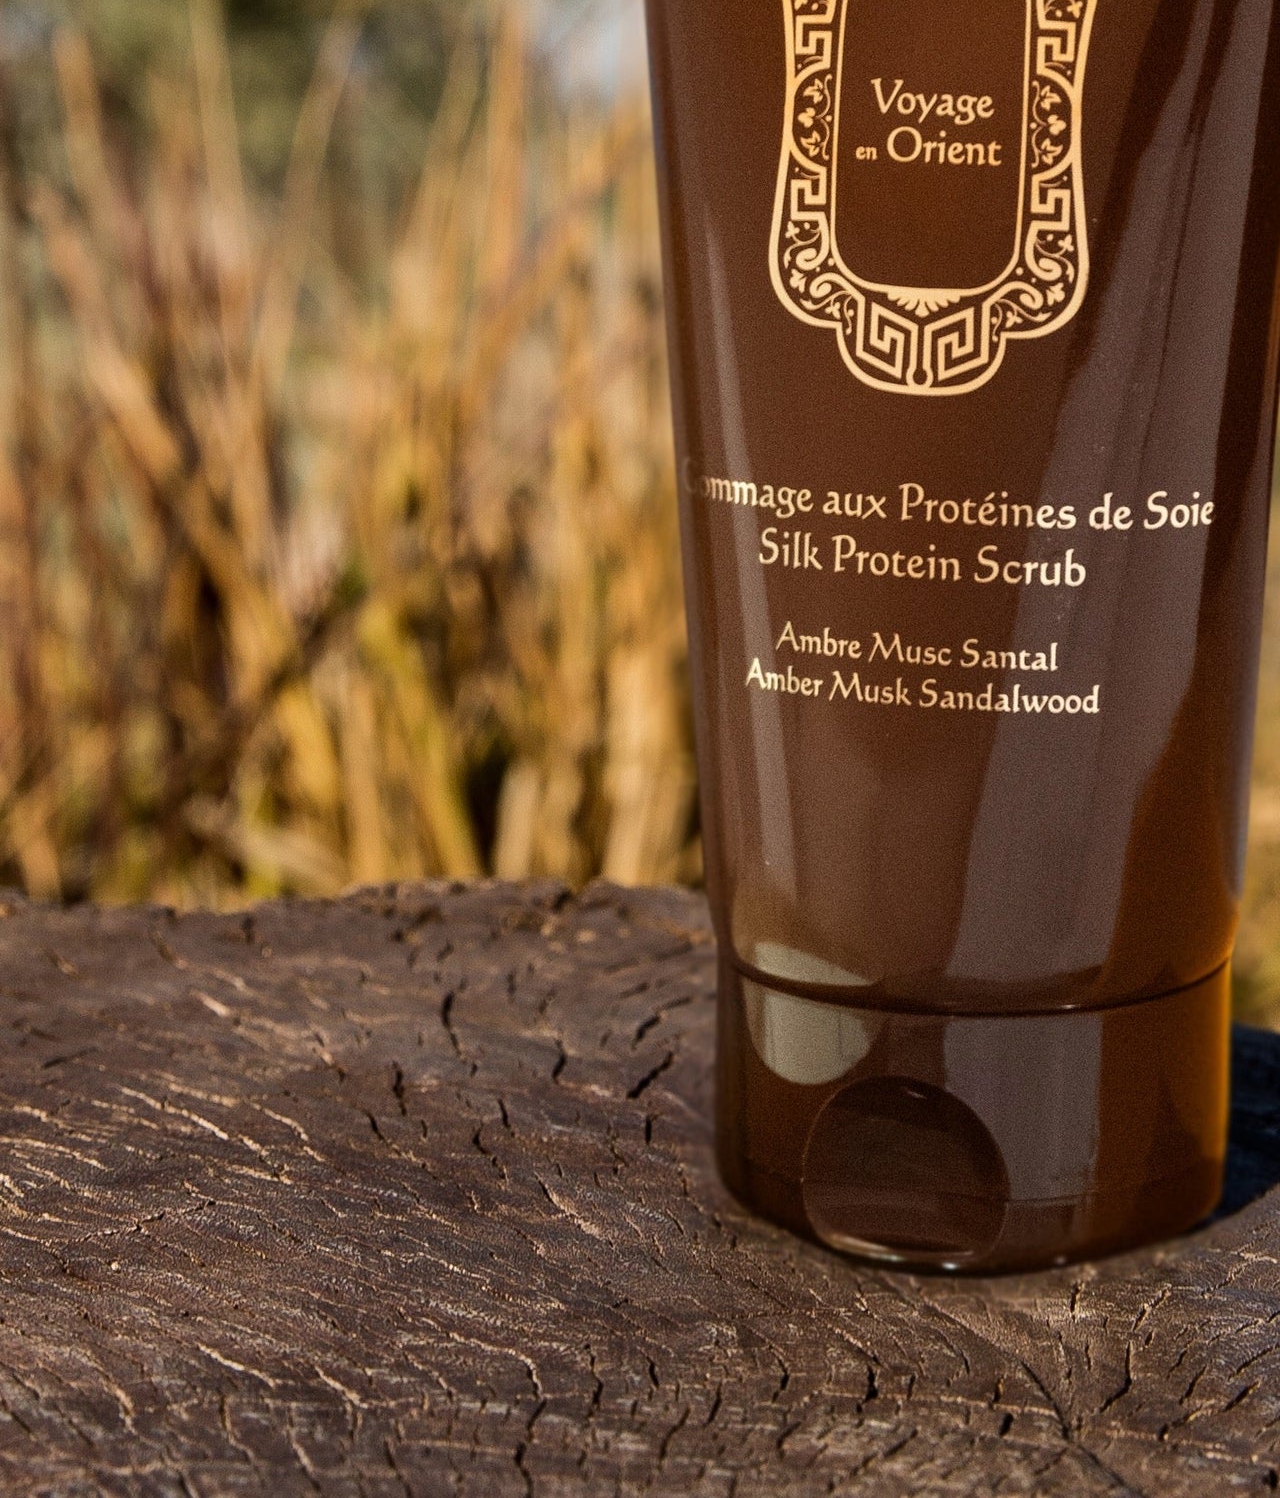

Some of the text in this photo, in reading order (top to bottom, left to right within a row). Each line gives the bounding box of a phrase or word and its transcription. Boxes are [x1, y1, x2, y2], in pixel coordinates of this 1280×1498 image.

[870, 77, 995, 125] Voyage
[855, 126, 1002, 167] en Orient
[822, 489, 888, 521] aux
[898, 482, 1077, 531] Protéines
[1088, 493, 1134, 532] de
[1143, 491, 1215, 531] Soie
[758, 527, 1087, 588] Silk Protein Scrub
[774, 620, 1058, 673] Ambre Musc Santal
[744, 657, 1101, 715] Amber Musk Sandalwood
